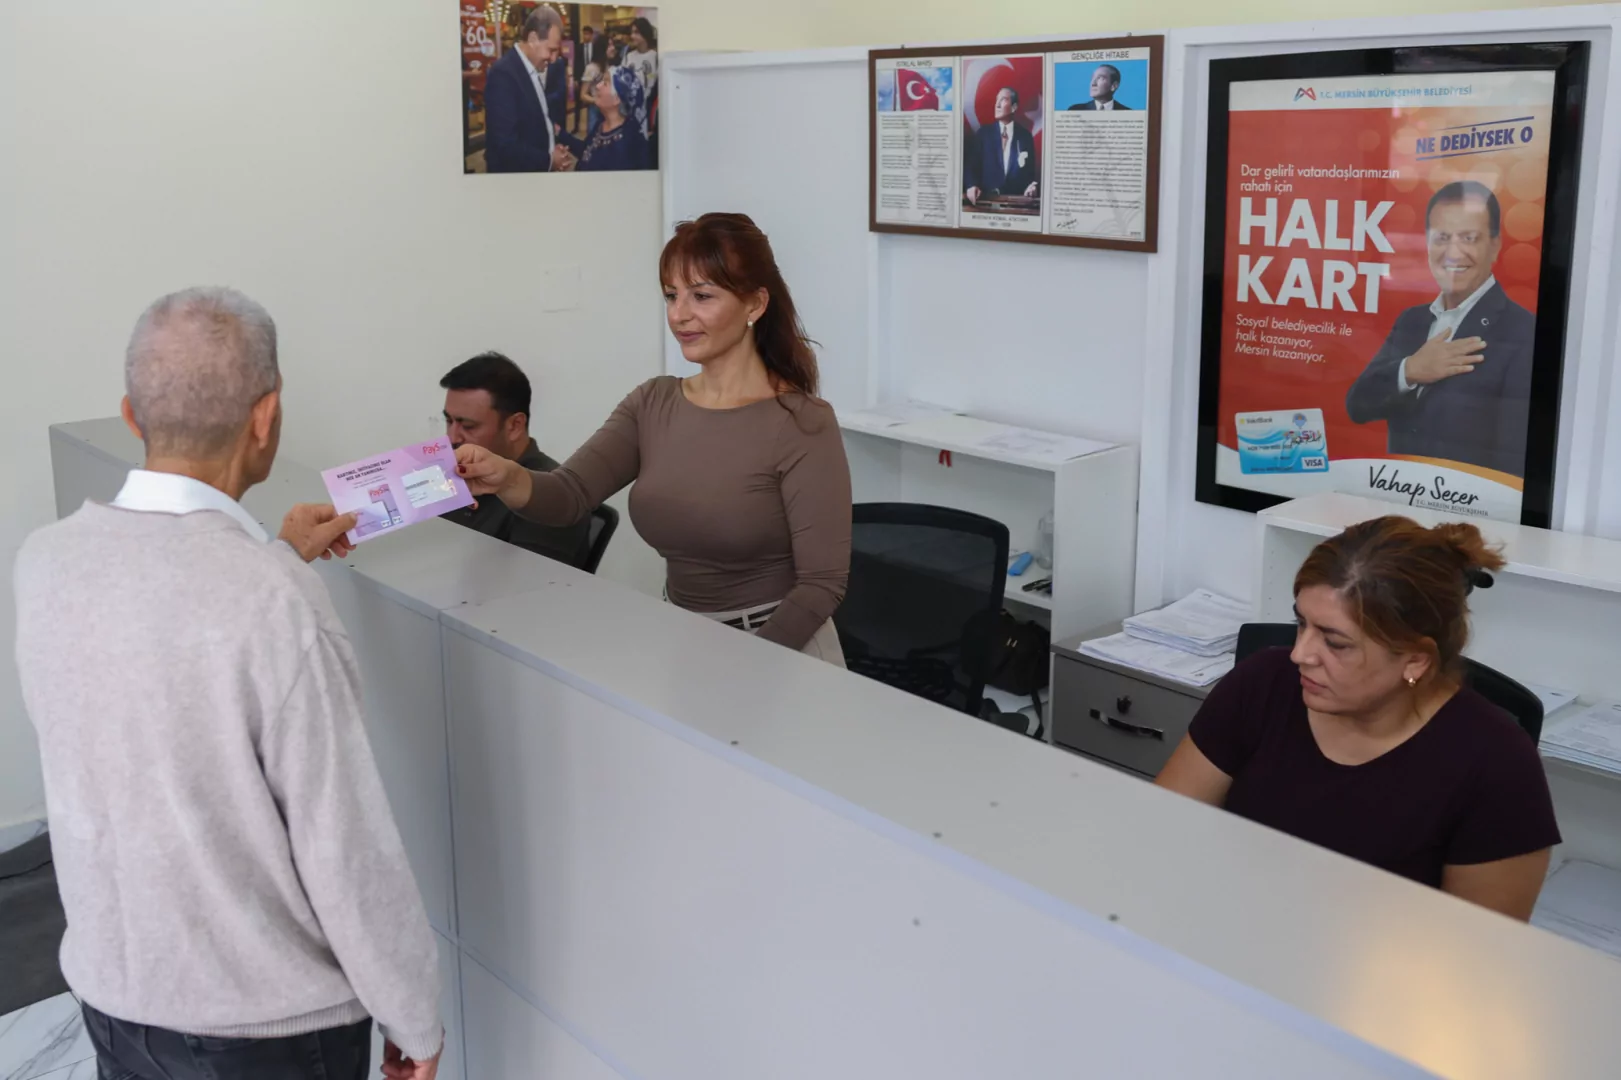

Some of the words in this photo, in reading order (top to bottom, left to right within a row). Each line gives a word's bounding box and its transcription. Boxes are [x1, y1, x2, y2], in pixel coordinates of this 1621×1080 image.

[466, 26, 486, 45] 60
[1335, 88, 1366, 98] MERSİN
[1424, 84, 1472, 96] BELEDİYESİ
[1416, 137, 1436, 154] NE
[1440, 127, 1515, 152] DEDİYSEK
[1520, 126, 1533, 143] O
[1240, 164, 1262, 177] Dar
[1264, 163, 1294, 180] gelirli
[1297, 164, 1400, 181] vatandaşlarımızın
[1240, 179, 1271, 192] rahatı
[1274, 180, 1293, 195] için
[1238, 196, 1396, 253] HALK
[1236, 254, 1391, 314] KART
[1236, 313, 1268, 329] Sosyal
[1271, 317, 1337, 334] belediyecilik
[1339, 324, 1353, 337] ile
[1235, 329, 1257, 342] halk
[1260, 332, 1314, 349] kazanıyor,
[1235, 342, 1270, 356] Mersin
[1272, 345, 1327, 364] kazanıyor.
[1304, 459, 1323, 467] VISA
[1368, 464, 1426, 506] Vahap
[1430, 476, 1479, 506] Seçer
